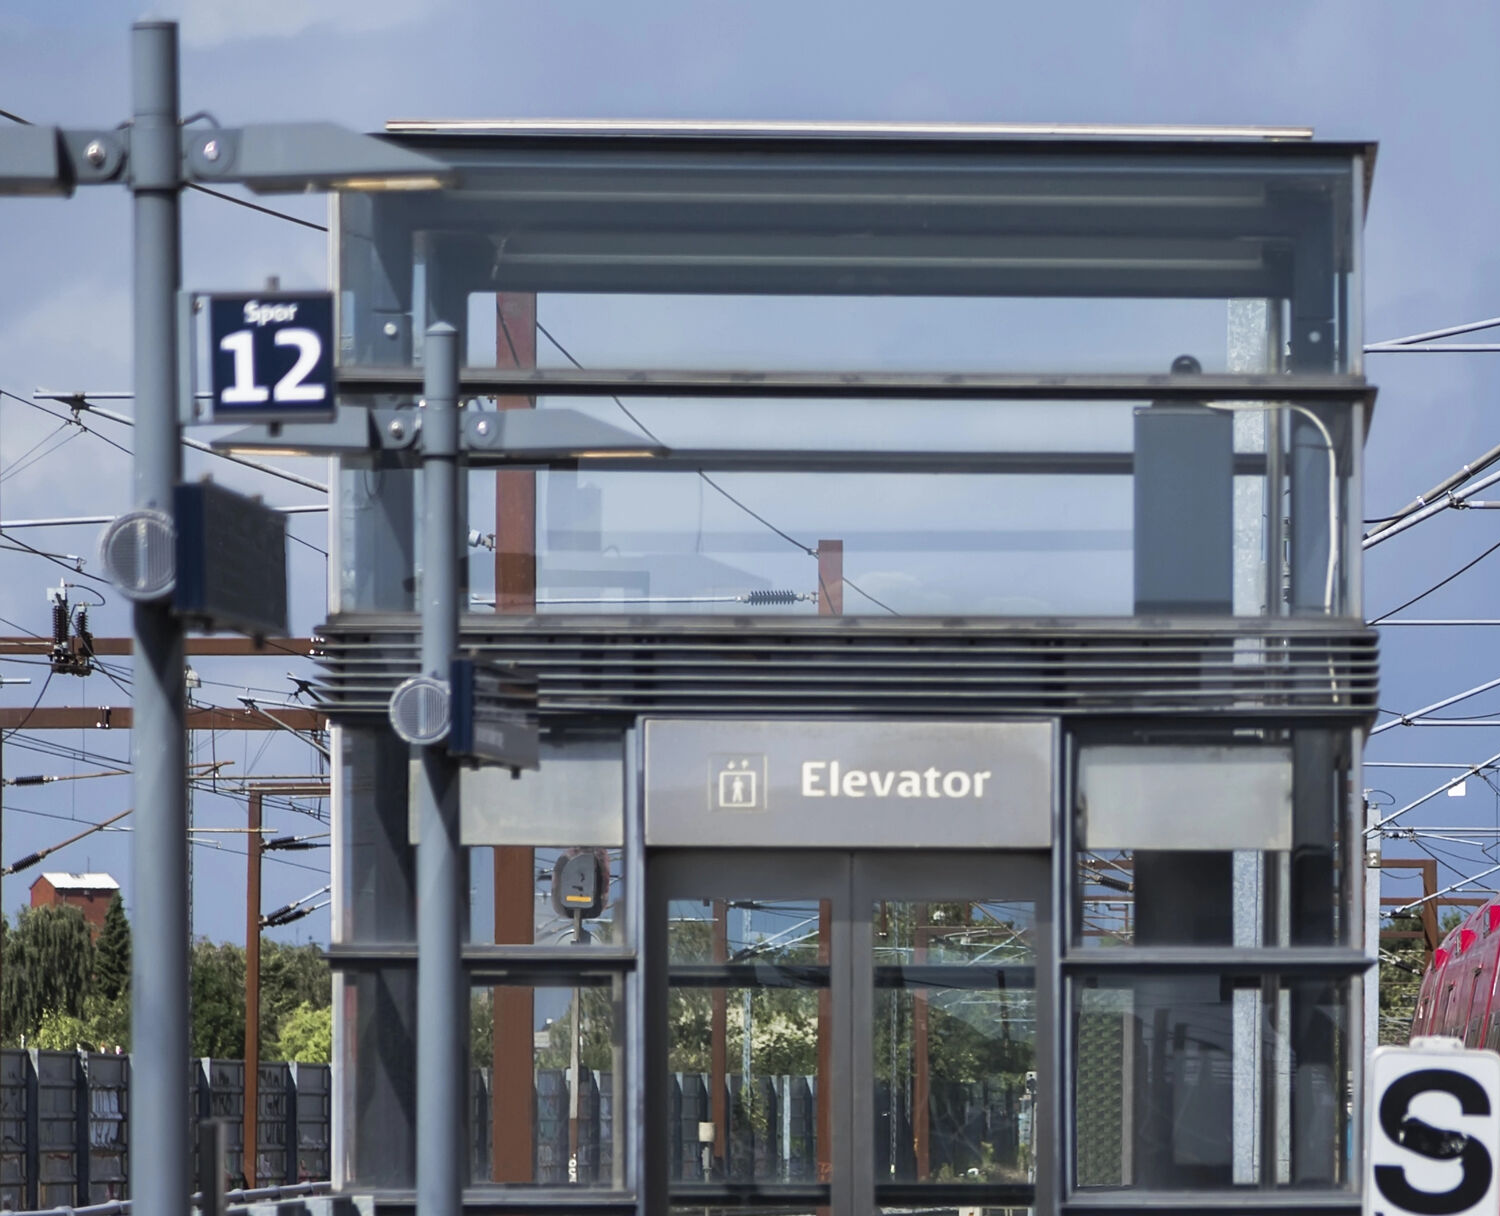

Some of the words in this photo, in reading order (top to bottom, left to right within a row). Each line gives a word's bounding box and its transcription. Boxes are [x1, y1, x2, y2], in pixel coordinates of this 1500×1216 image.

[243, 300, 298, 326] Spor
[220, 328, 326, 403] 12
[801, 760, 991, 798] Elevator
[1373, 1068, 1493, 1216] S
